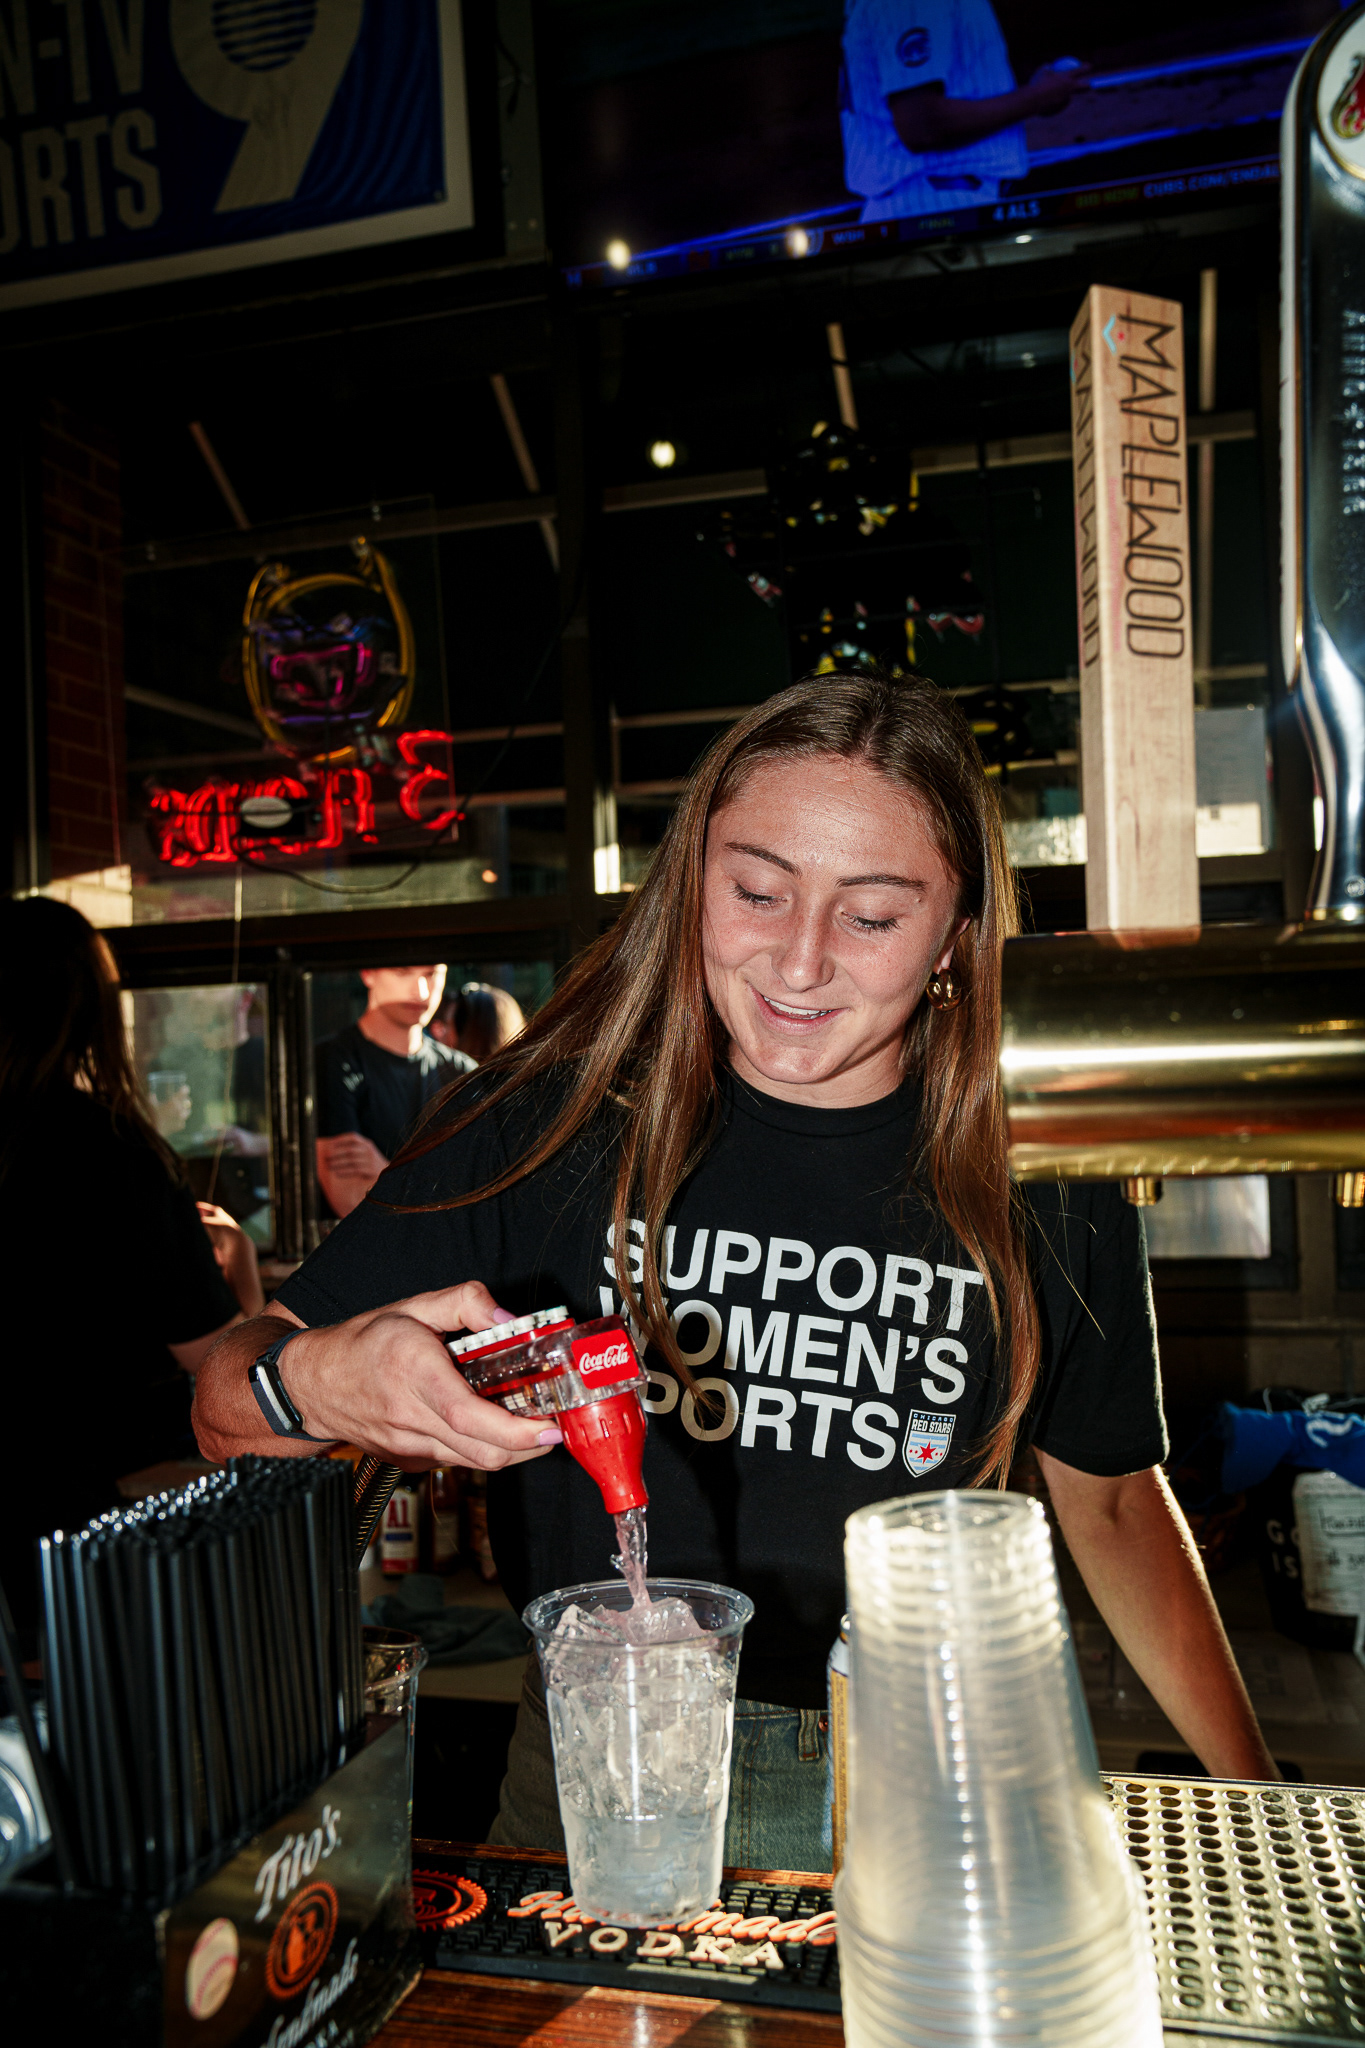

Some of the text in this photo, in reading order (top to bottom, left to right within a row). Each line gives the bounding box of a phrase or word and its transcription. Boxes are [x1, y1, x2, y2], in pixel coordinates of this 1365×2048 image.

[1118, 314, 1185, 659] MAPLEWOOD
[603, 1218, 985, 1332] SUPPORT
[911, 1418, 952, 1434] RED STARS
[913, 1412, 954, 1423] CHICAGO
[254, 1803, 342, 1924] Tito's
[544, 1919, 785, 1971] VODKA
